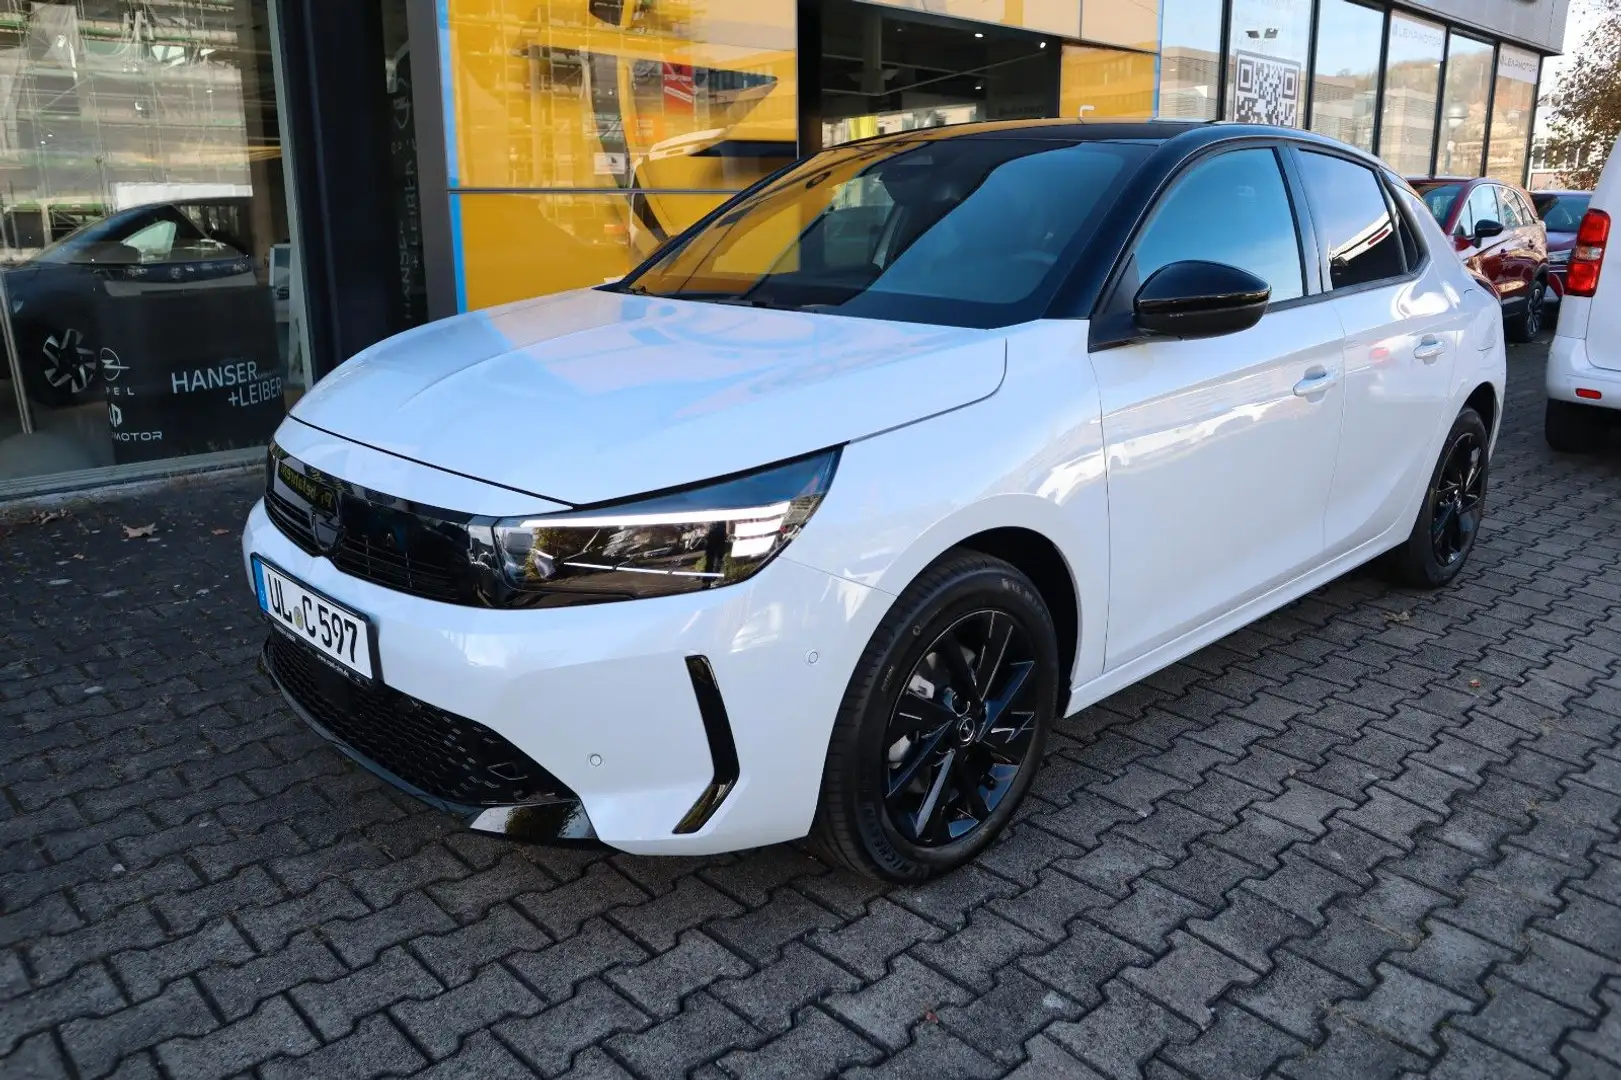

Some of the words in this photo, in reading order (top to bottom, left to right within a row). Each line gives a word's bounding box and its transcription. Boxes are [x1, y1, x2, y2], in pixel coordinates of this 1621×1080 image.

[170, 361, 260, 394] HANSER
[228, 377, 284, 407] +LEIBER
[268, 573, 293, 624] UL
[302, 595, 316, 638] C
[318, 603, 358, 664] 597
